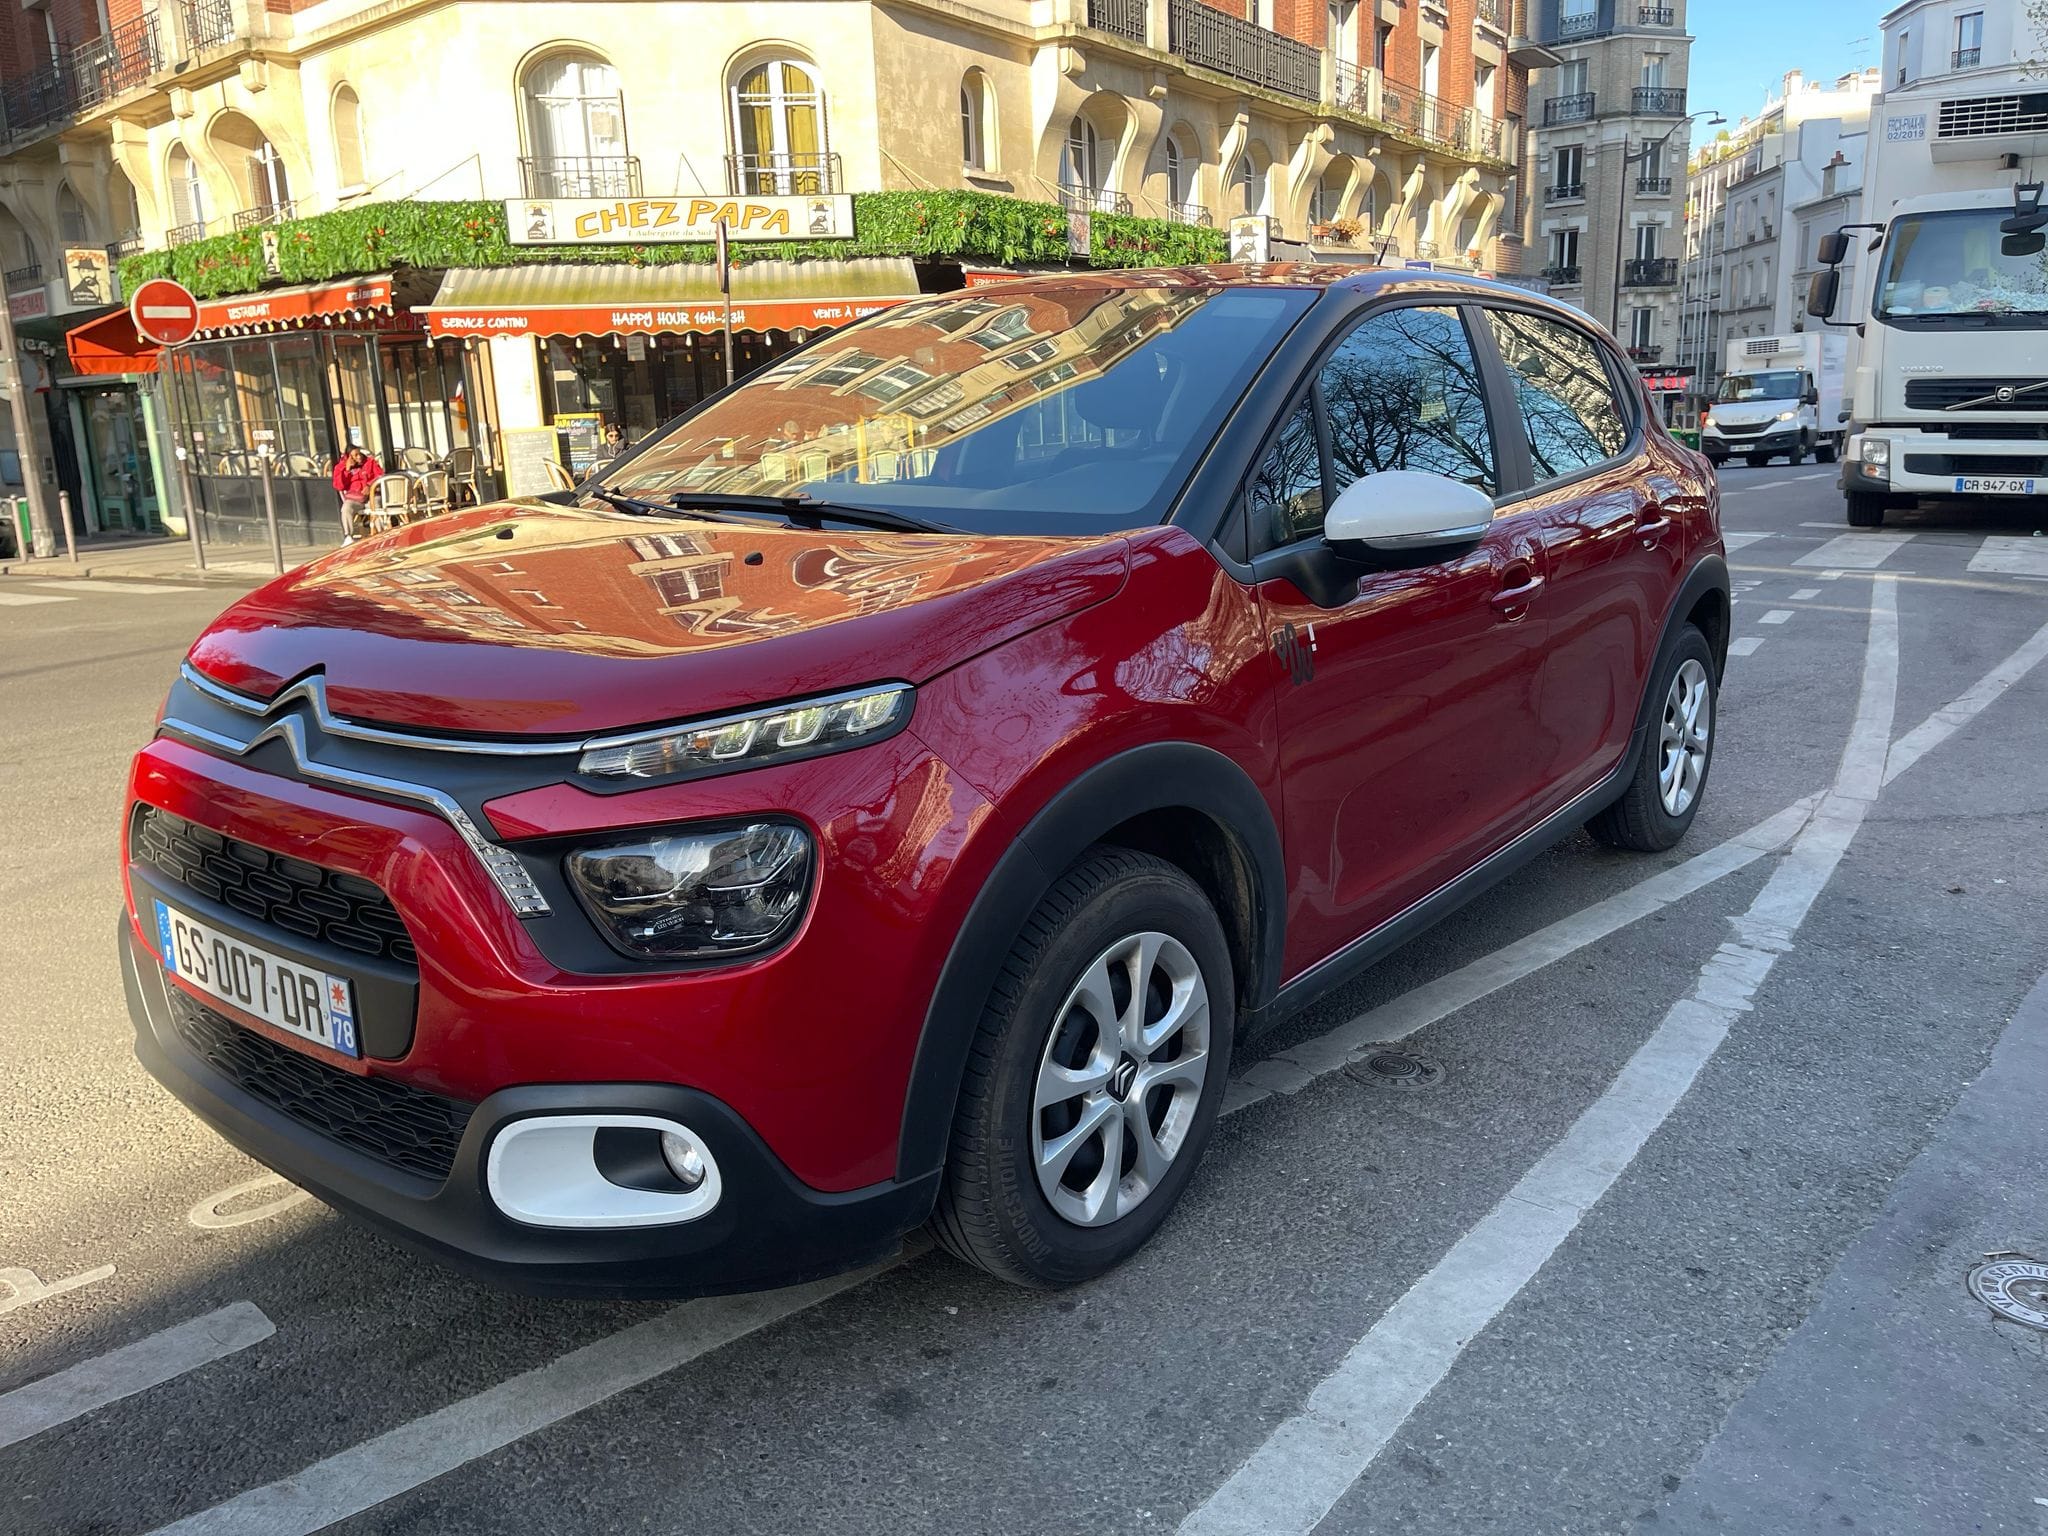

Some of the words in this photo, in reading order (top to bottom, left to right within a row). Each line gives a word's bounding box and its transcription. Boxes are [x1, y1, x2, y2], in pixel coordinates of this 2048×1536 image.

[1888, 130, 1924, 140] 02/2019
[575, 201, 680, 238] CHEZ
[687, 200, 790, 235] PAPA
[813, 308, 842, 319] VENTE
[844, 305, 853, 318] À
[441, 317, 485, 328] SERVICE
[487, 317, 528, 328] CONTINU
[612, 311, 653, 327] HAPPY
[657, 312, 690, 325] HOUR
[1900, 365, 1945, 373] VOLVO
[1964, 480, 2025, 491] CR-947-GX
[165, 944, 172, 960] F
[175, 919, 325, 1037] GS-007-DR
[332, 1016, 354, 1049] 78
